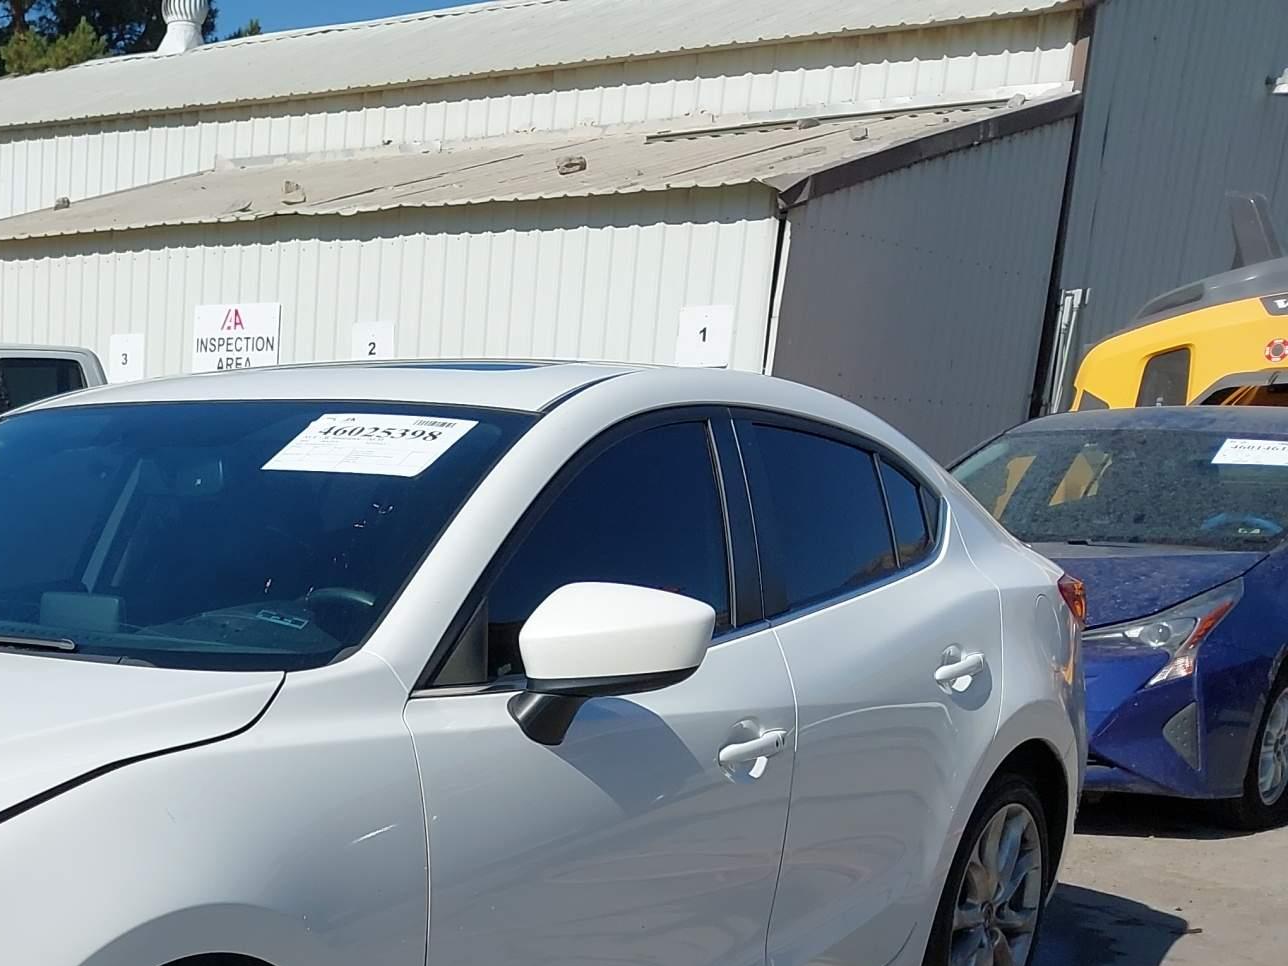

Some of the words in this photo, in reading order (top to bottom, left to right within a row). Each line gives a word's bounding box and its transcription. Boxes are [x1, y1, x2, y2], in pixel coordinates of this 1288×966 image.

[699, 327, 707, 342] 1
[196, 336, 275, 353] INSPECTION
[368, 341, 377, 356] 2
[121, 352, 129, 366] 3
[318, 425, 443, 442] 46025398
